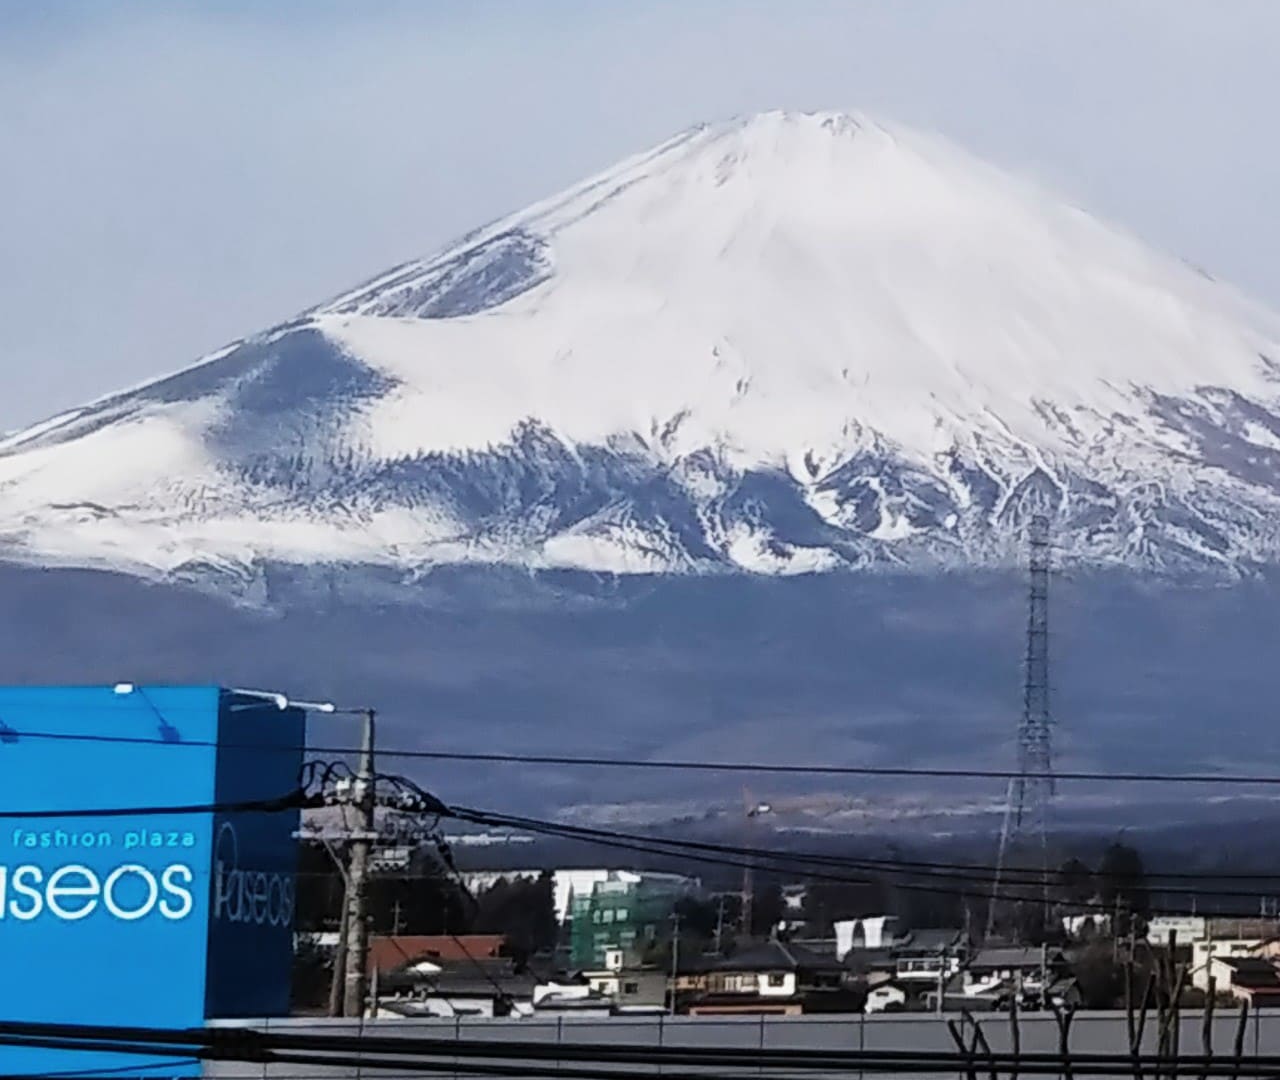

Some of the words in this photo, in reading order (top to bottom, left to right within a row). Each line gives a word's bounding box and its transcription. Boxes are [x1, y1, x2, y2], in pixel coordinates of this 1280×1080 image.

[13, 829, 112, 848] fashion
[124, 829, 196, 849] plaza
[0, 864, 193, 920] seos
